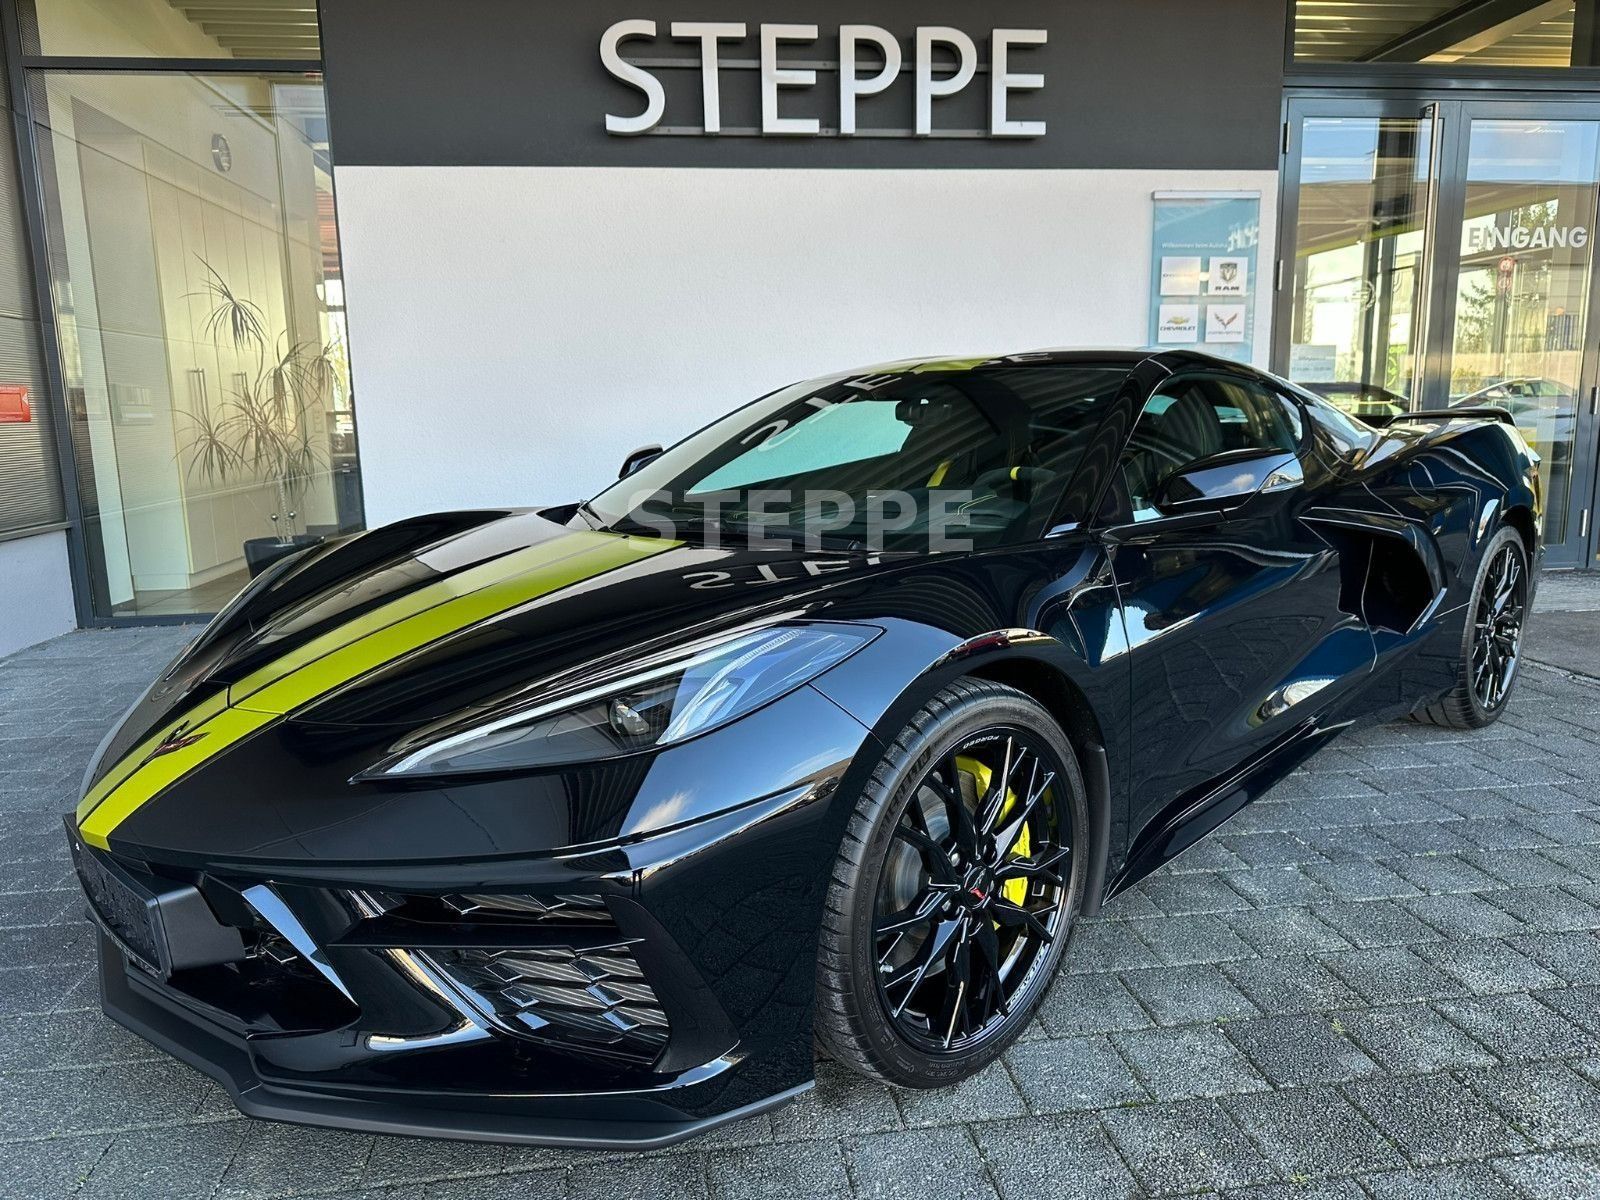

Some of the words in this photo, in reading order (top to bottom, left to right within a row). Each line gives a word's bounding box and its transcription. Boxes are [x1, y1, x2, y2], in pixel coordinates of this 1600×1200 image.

[600, 19, 1048, 137] STEPPE
[1468, 226, 1588, 249] EINGANG
[962, 735, 1000, 750] FORGED
